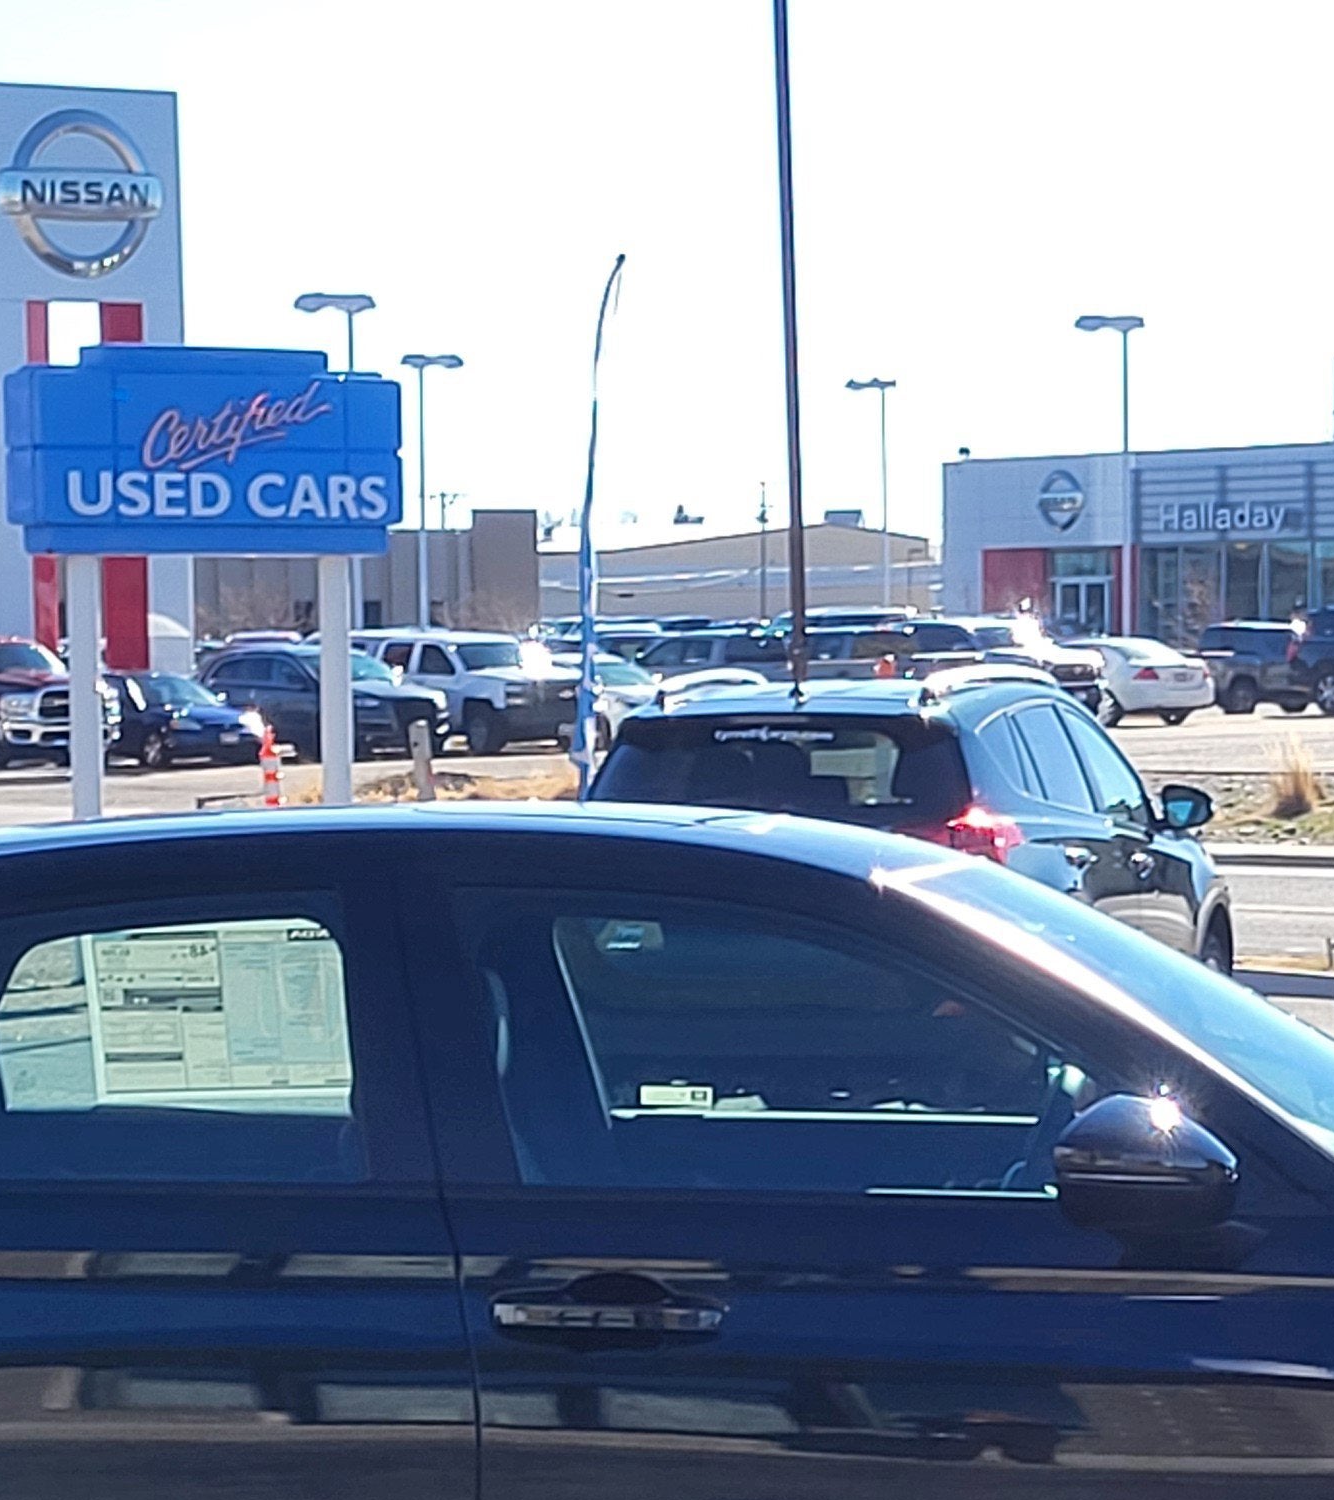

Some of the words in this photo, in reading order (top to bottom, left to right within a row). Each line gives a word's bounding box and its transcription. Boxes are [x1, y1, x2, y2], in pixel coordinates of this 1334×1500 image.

[21, 178, 150, 208] NISSAN
[142, 381, 332, 470] Certified
[67, 470, 232, 518] USED
[246, 472, 389, 520] CARS
[1159, 500, 1285, 533] Halladay
